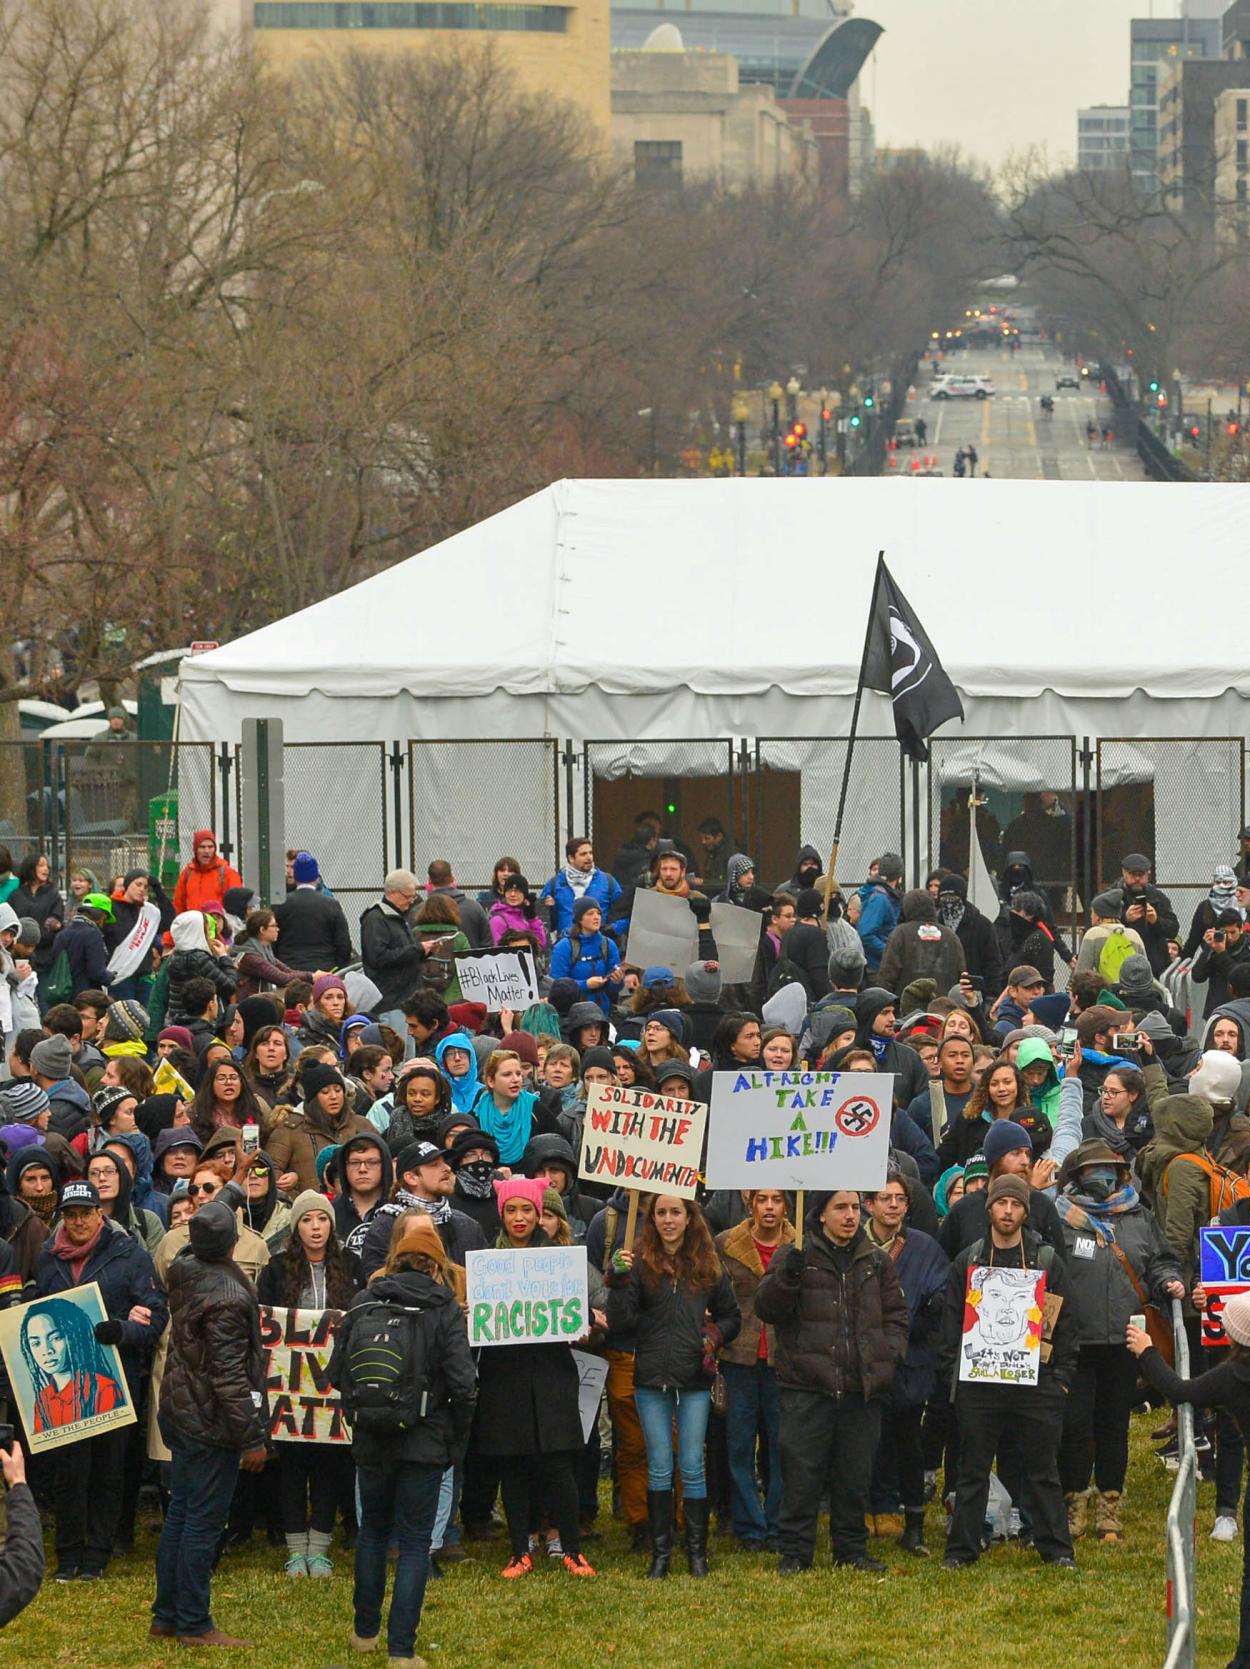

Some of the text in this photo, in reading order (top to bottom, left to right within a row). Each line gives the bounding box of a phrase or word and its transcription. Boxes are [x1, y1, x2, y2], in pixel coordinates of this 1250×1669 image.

[732, 1072, 841, 1093] ALT-RIGHT
[599, 1086, 701, 1115] SOLIDARITY
[775, 1089, 834, 1109] TAKE
[591, 1107, 692, 1145] WITH THE
[790, 1110, 807, 1131] A
[745, 1131, 838, 1162] HIKE!!!
[584, 1144, 699, 1188] UNDOCUMENTED
[1076, 1236, 1096, 1250] NO!
[472, 1250, 516, 1276] Good
[259, 1306, 343, 1347] BLA
[473, 1297, 583, 1342] RACISTS
[1000, 1368, 1036, 1381] LOSER
[42, 1429, 60, 1439] WE
[62, 1423, 81, 1433] THE
[83, 1409, 120, 1427] PEOPLE
